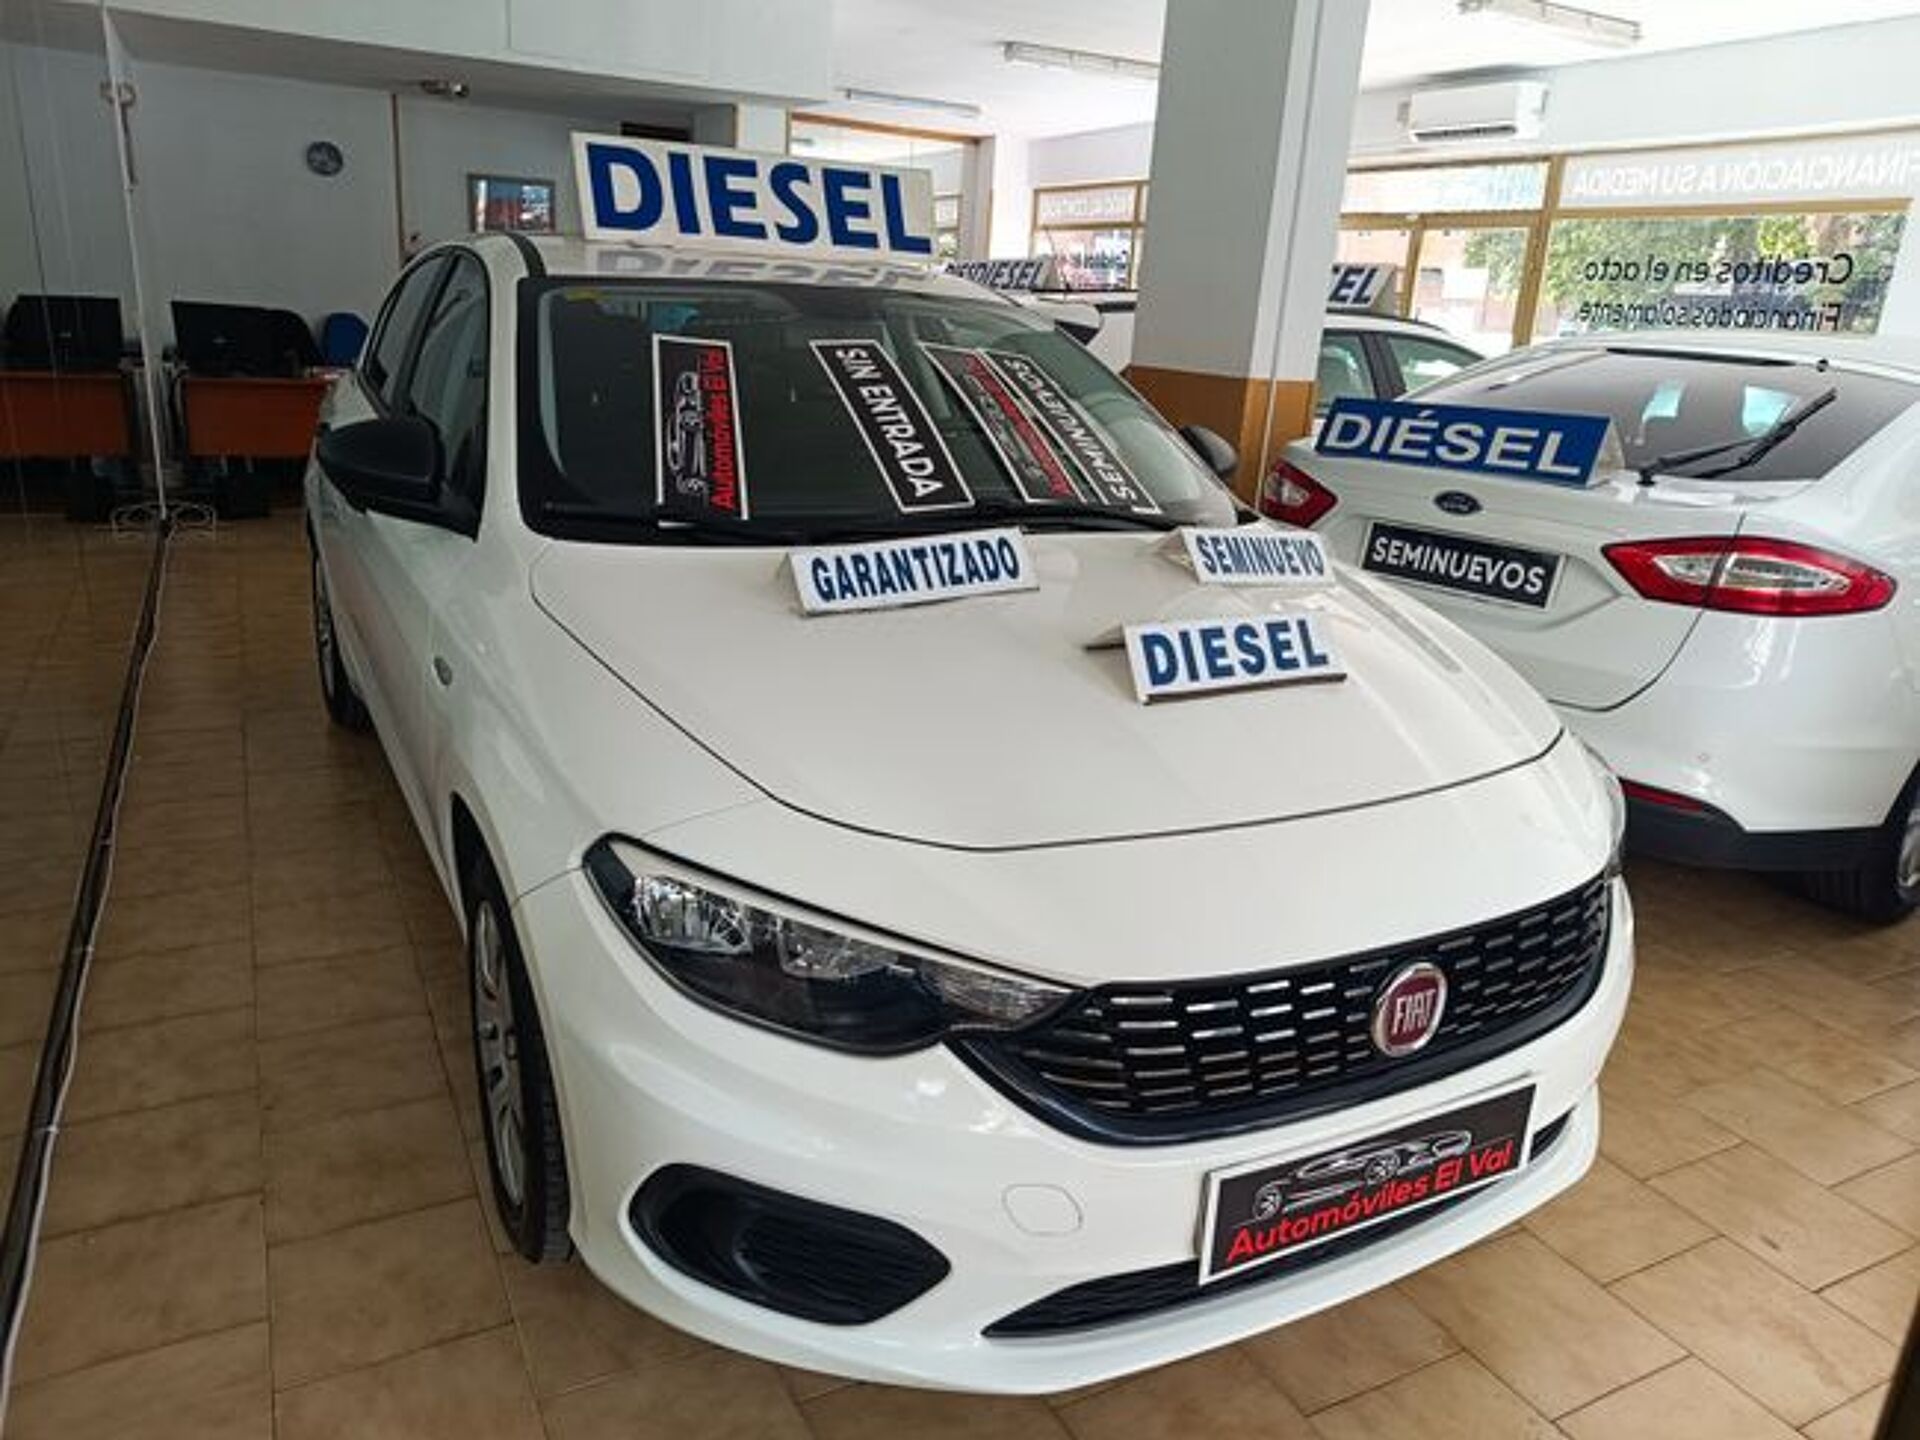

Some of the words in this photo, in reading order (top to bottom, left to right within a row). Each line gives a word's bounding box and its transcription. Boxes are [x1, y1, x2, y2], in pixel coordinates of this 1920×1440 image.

[587, 142, 932, 254] DIESEL
[1328, 265, 1379, 304] EL
[835, 348, 882, 379] SIN
[858, 385, 944, 497] ENTRADA
[1003, 358, 1138, 501] SEMINUEVOS
[1325, 409, 1583, 475] DIÉSEL
[811, 535, 1020, 603] GARANTIZADO
[1199, 533, 1327, 576] SEMINUEVO
[1371, 535, 1546, 595] SEMINUEVOS
[1141, 619, 1329, 688] DIESEL
[1391, 988, 1436, 1034] FIAT
[1226, 1177, 1428, 1262] Automóviles
[1434, 1159, 1463, 1192] El
[1468, 1139, 1514, 1179] Val
